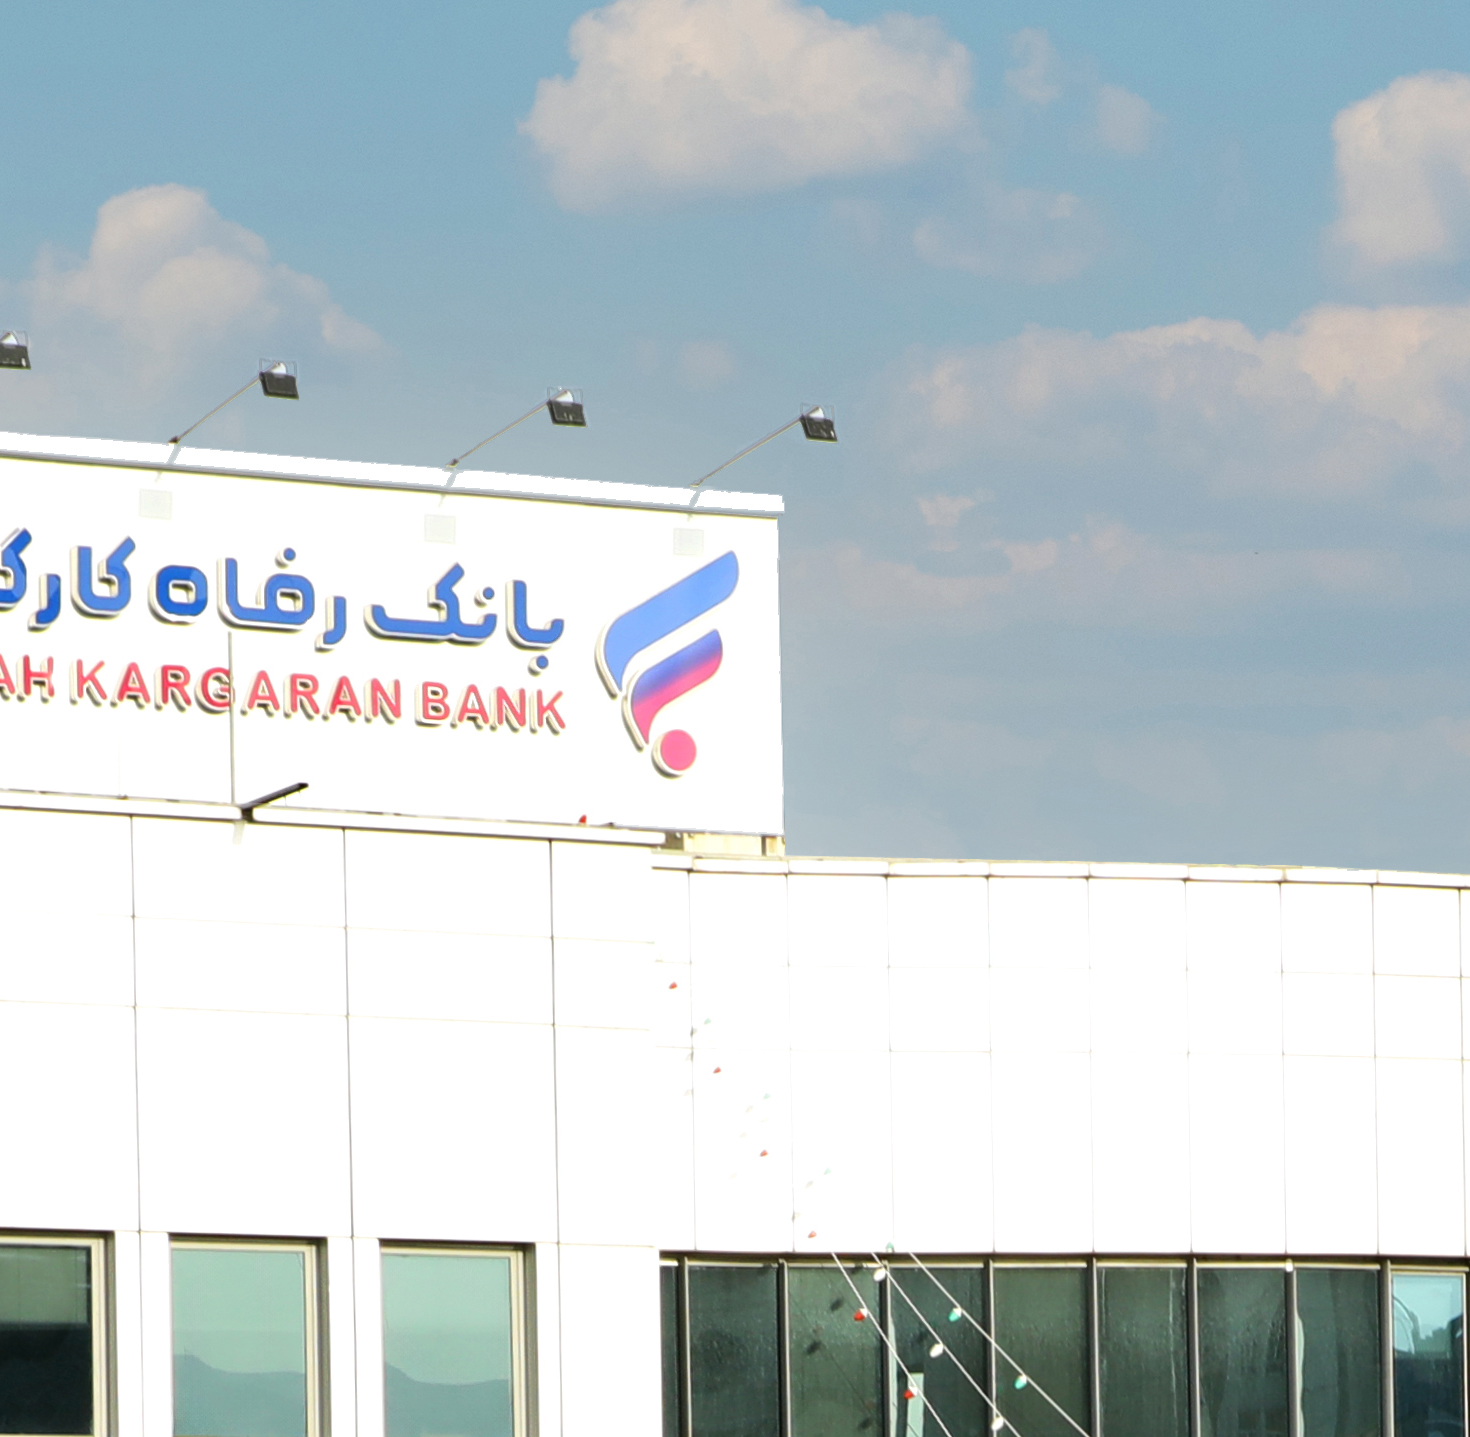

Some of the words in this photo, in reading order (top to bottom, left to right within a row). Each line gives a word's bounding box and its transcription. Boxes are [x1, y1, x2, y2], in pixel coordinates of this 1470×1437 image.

[149, 547, 348, 651] رفاه
[364, 562, 566, 674] بانک
[70, 658, 403, 723] KARGARAN
[414, 680, 567, 734] BANK
